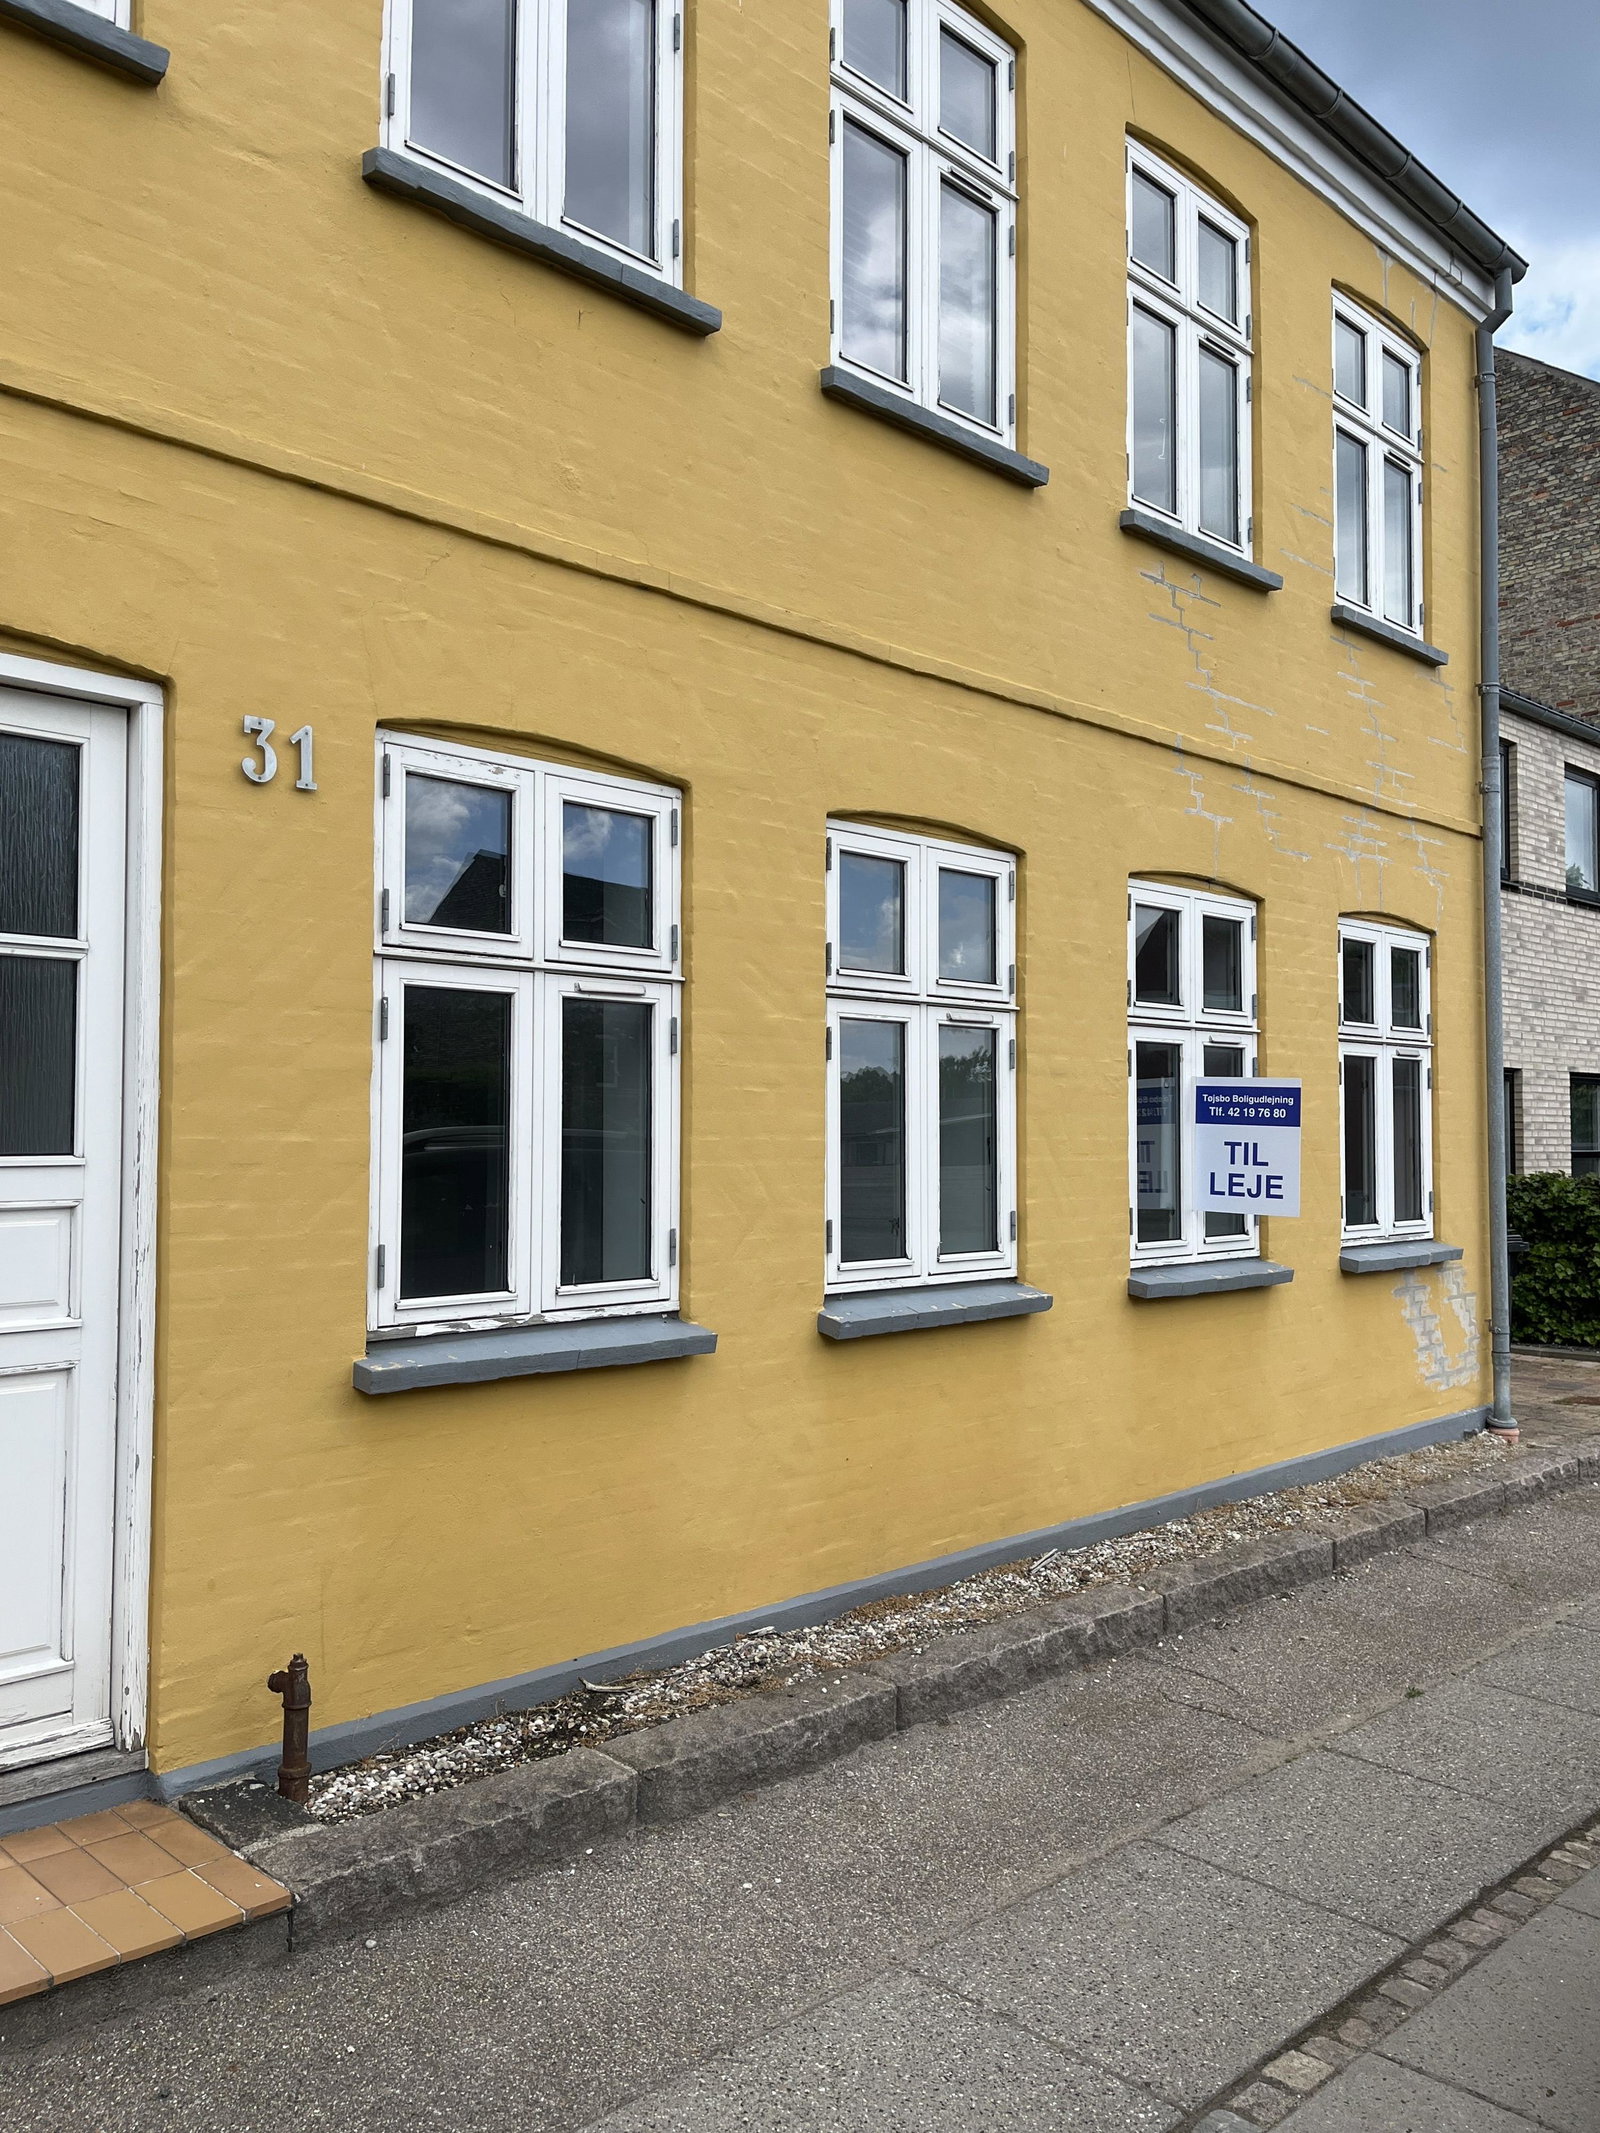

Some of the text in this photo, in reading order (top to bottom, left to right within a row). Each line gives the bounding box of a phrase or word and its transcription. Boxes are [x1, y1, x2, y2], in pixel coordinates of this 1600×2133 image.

[242, 714, 318, 790] 31
[1209, 1106, 1286, 1119] Tlf. 42 19 76 80
[1232, 1094, 1294, 1106] Boligudlejning
[1224, 1141, 1269, 1167] TIL
[1209, 1171, 1284, 1200] LEJE
